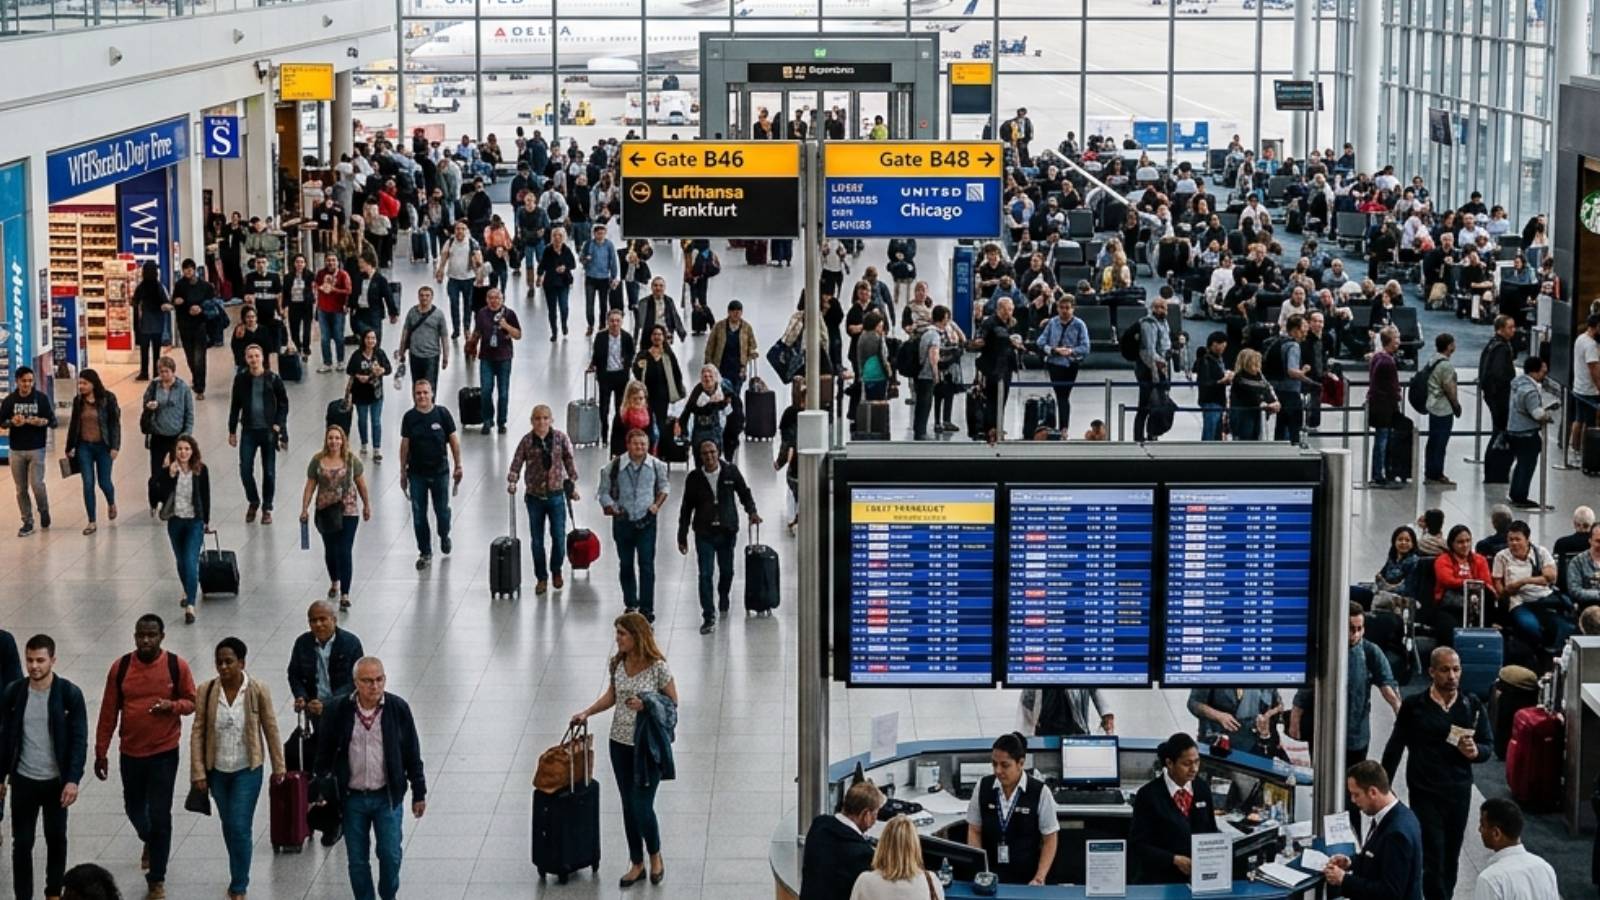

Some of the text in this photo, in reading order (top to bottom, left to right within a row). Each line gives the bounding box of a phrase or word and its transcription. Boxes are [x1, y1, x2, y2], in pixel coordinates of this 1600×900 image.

[512, 26, 571, 36] DELA
[654, 151, 744, 168] Gate B46
[880, 151, 970, 168] Gate B48
[662, 185, 744, 199] Lufthansa
[663, 203, 737, 217] Frankfurt
[900, 203, 962, 220] Chicago
[129, 198, 160, 284] WH
